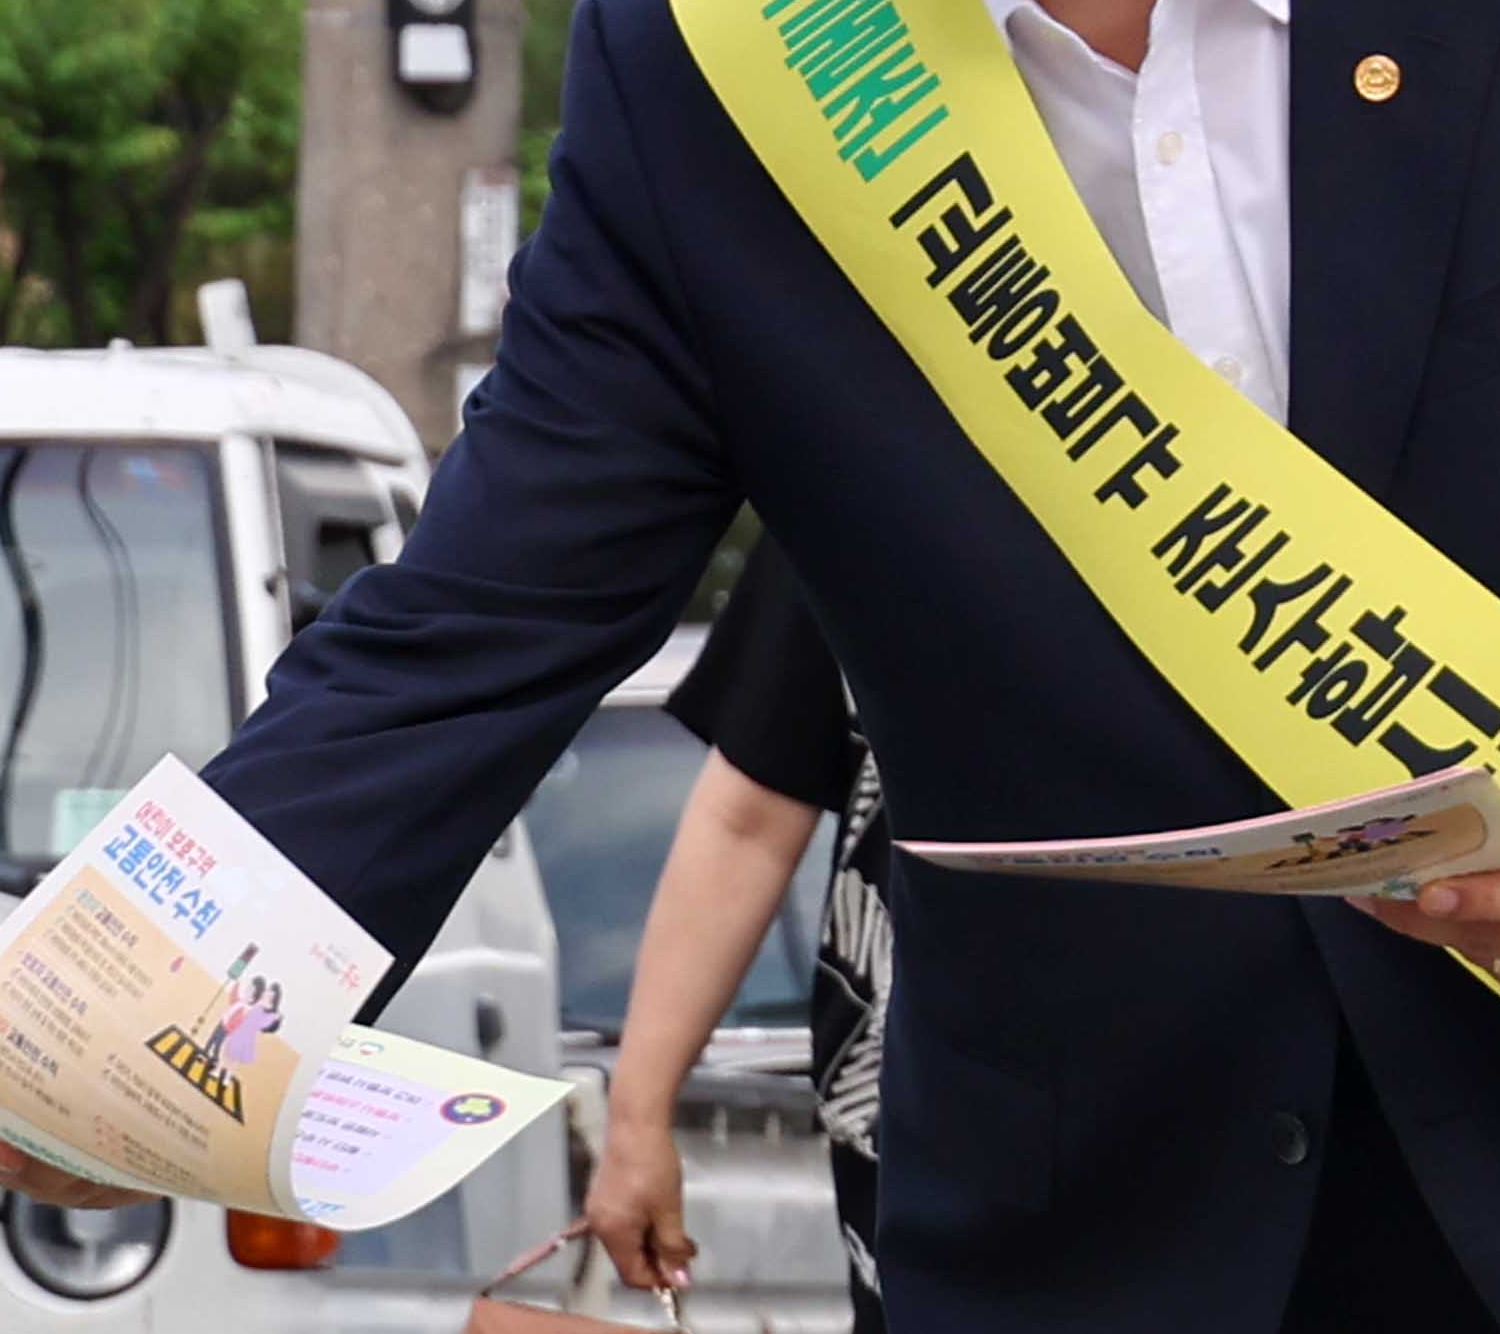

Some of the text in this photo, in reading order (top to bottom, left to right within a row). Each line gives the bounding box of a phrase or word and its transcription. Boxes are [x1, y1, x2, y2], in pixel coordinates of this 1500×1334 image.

[888, 151, 1182, 511] 교통법규
[103, 823, 223, 940] 교통안전 수칙
[135, 800, 217, 879] 어린이 보호구역
